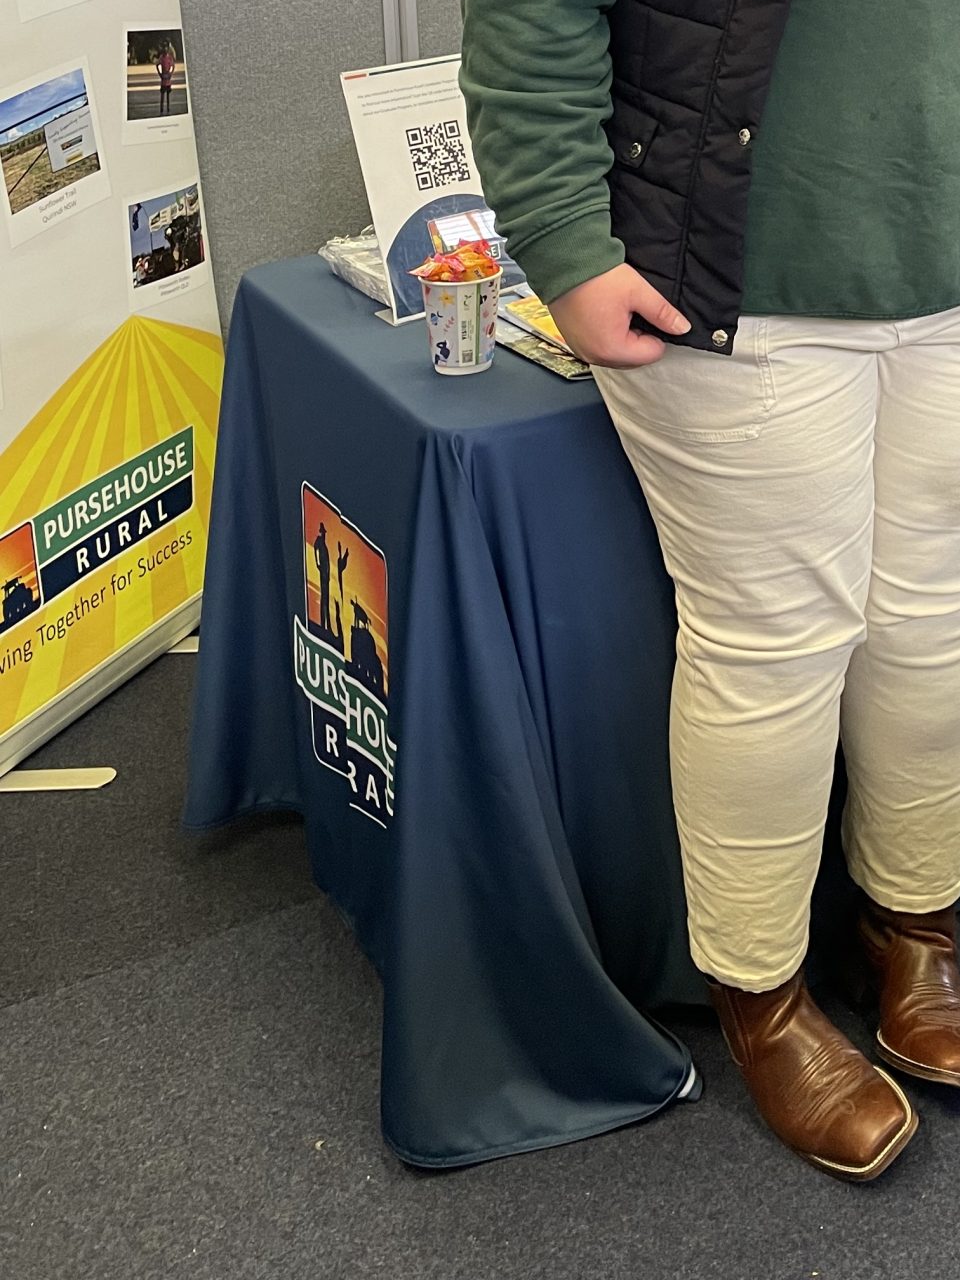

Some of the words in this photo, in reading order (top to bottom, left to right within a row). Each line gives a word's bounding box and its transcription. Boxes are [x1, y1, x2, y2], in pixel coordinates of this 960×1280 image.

[44, 442, 187, 549] PURSEHOUSE
[76, 500, 168, 573] RURAL
[37, 588, 106, 646] Together
[110, 568, 132, 596] for
[138, 530, 192, 578] Success
